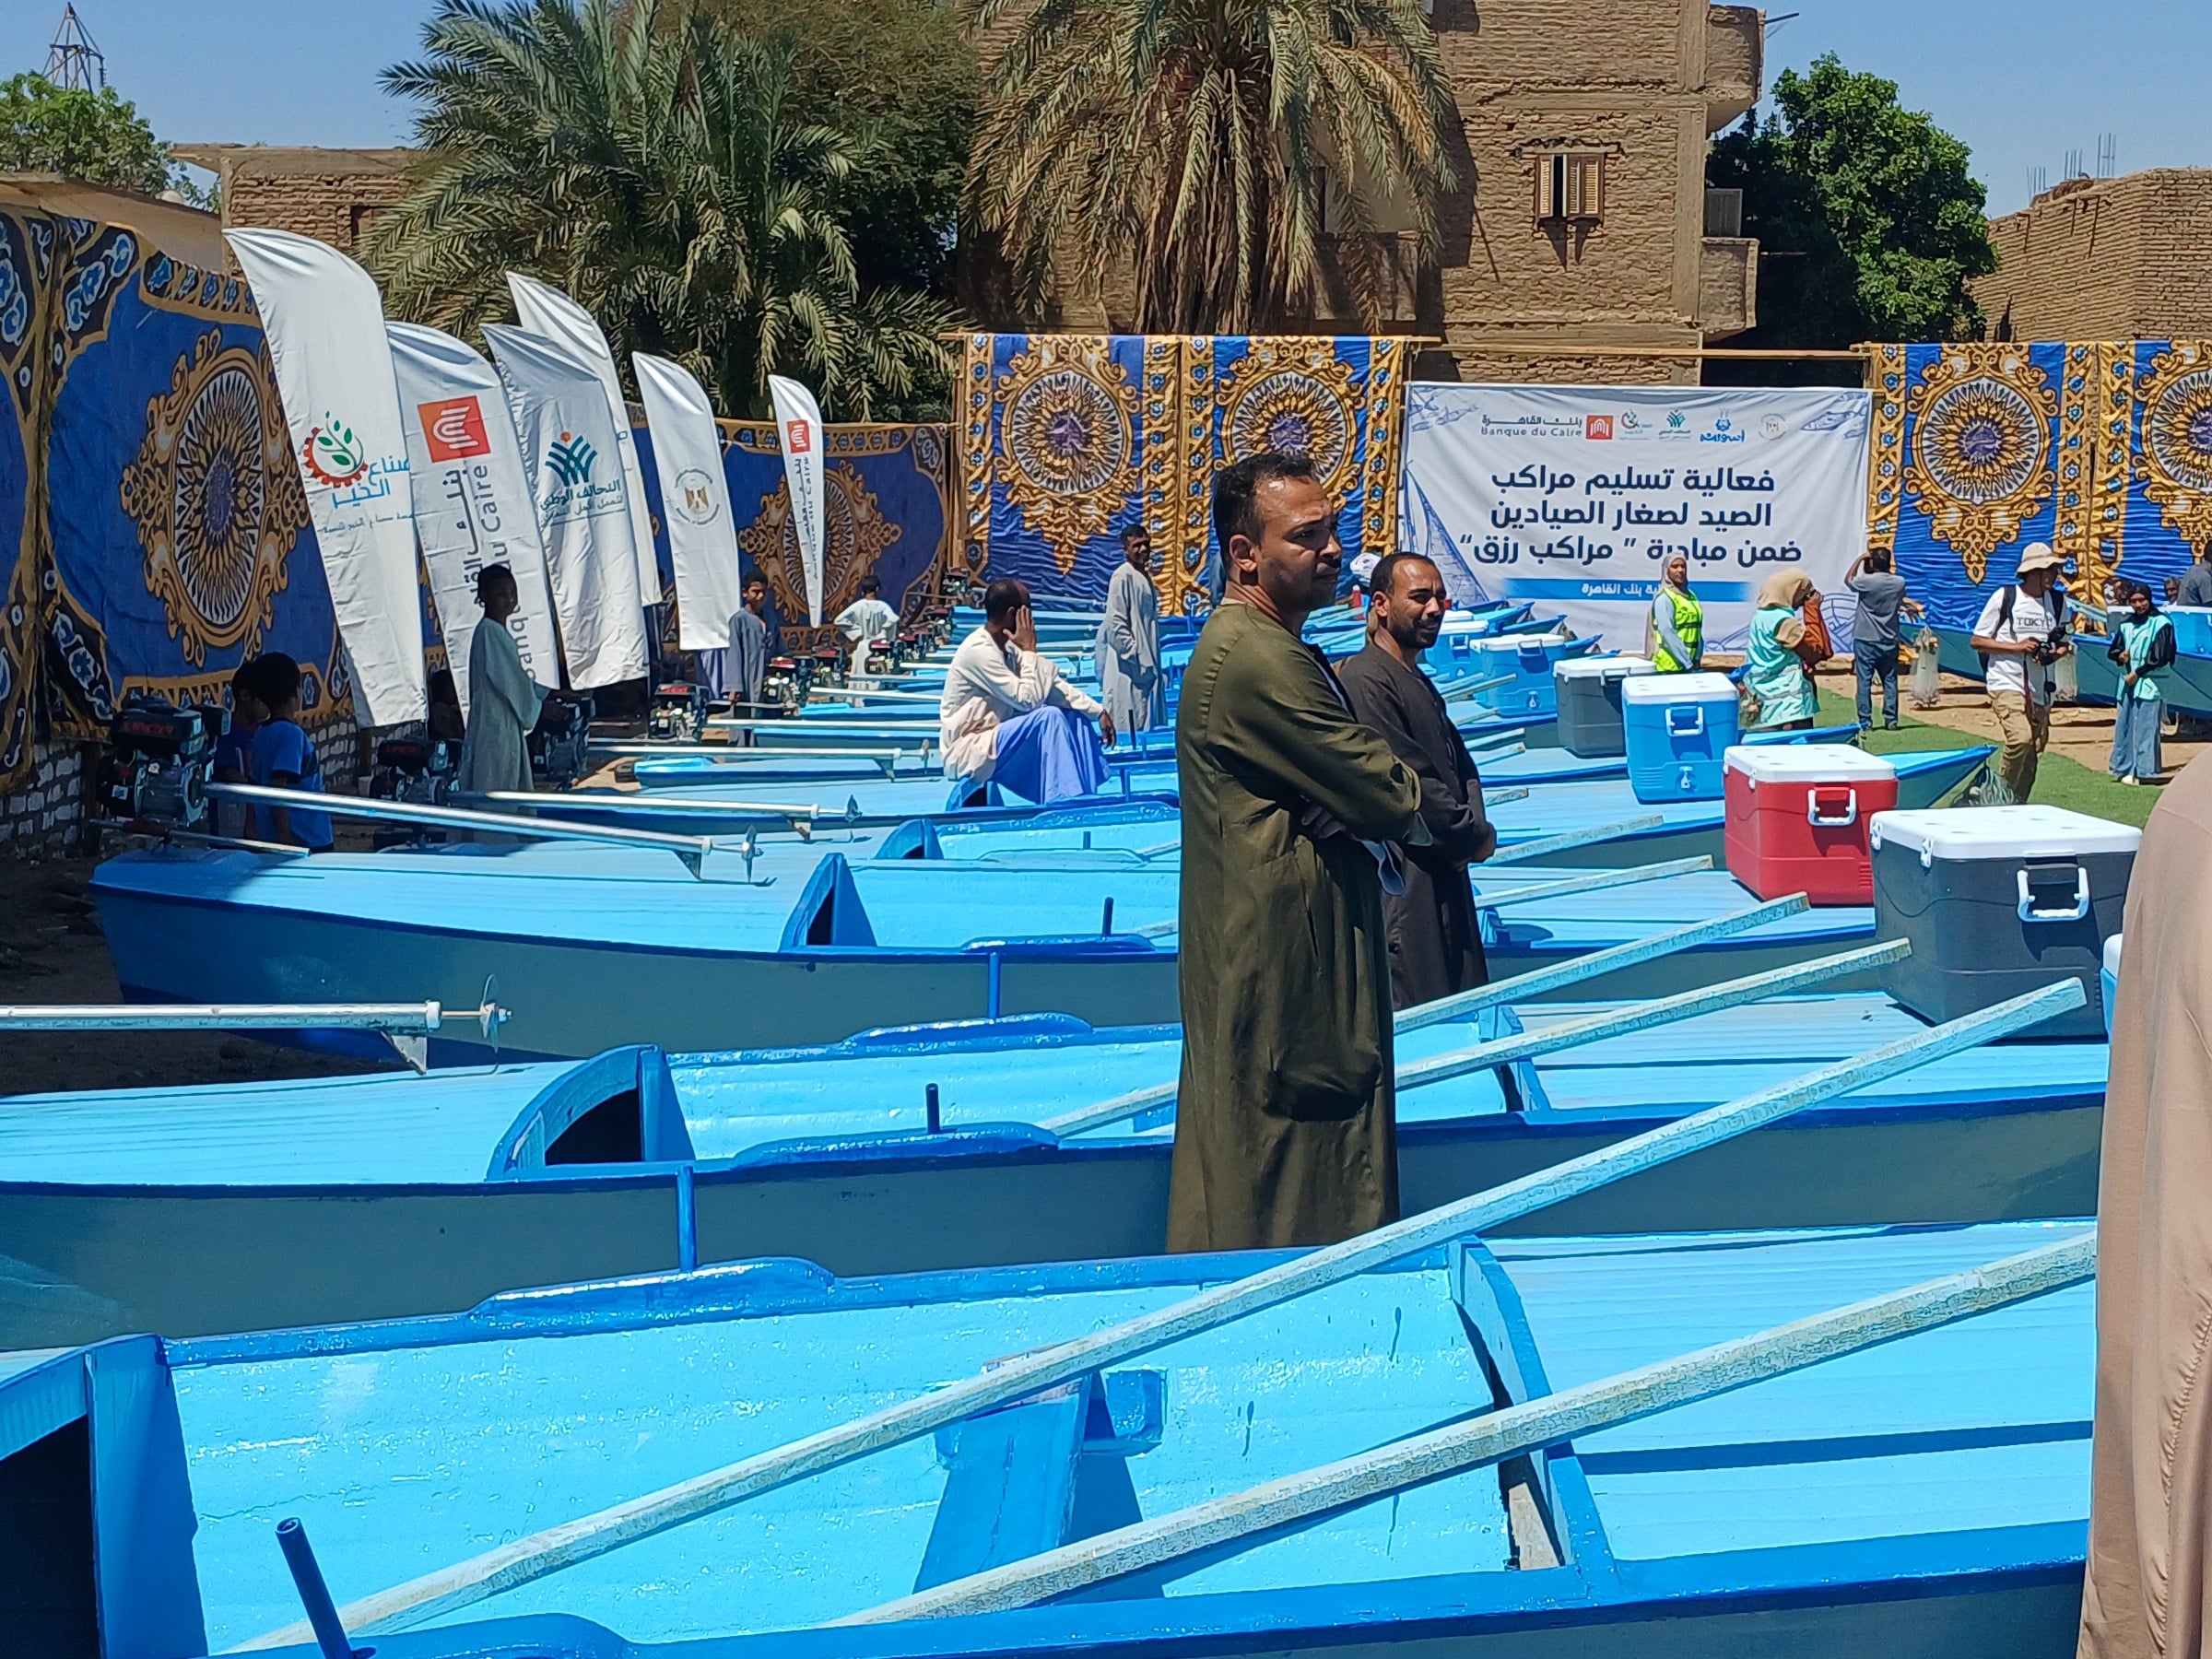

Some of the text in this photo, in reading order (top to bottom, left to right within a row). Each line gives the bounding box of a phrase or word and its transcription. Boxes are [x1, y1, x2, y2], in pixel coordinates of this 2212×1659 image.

[1481, 427, 1583, 437] Banque du Caire
[1482, 414, 1542, 426] القاهرة
[332, 478, 391, 509] الخير
[577, 479, 621, 500] التحالف
[1491, 465, 1775, 498] فعالية تسليم مراكب
[442, 467, 479, 556] بنك
[473, 465, 501, 533] Caire
[1490, 500, 1771, 532] الصيد لصغار الصيادين
[1529, 535, 1613, 566] مراكب
[1737, 539, 1802, 569] ضمن
[1581, 582, 1621, 596] القاهرة
[1623, 583, 1642, 597] بنك
